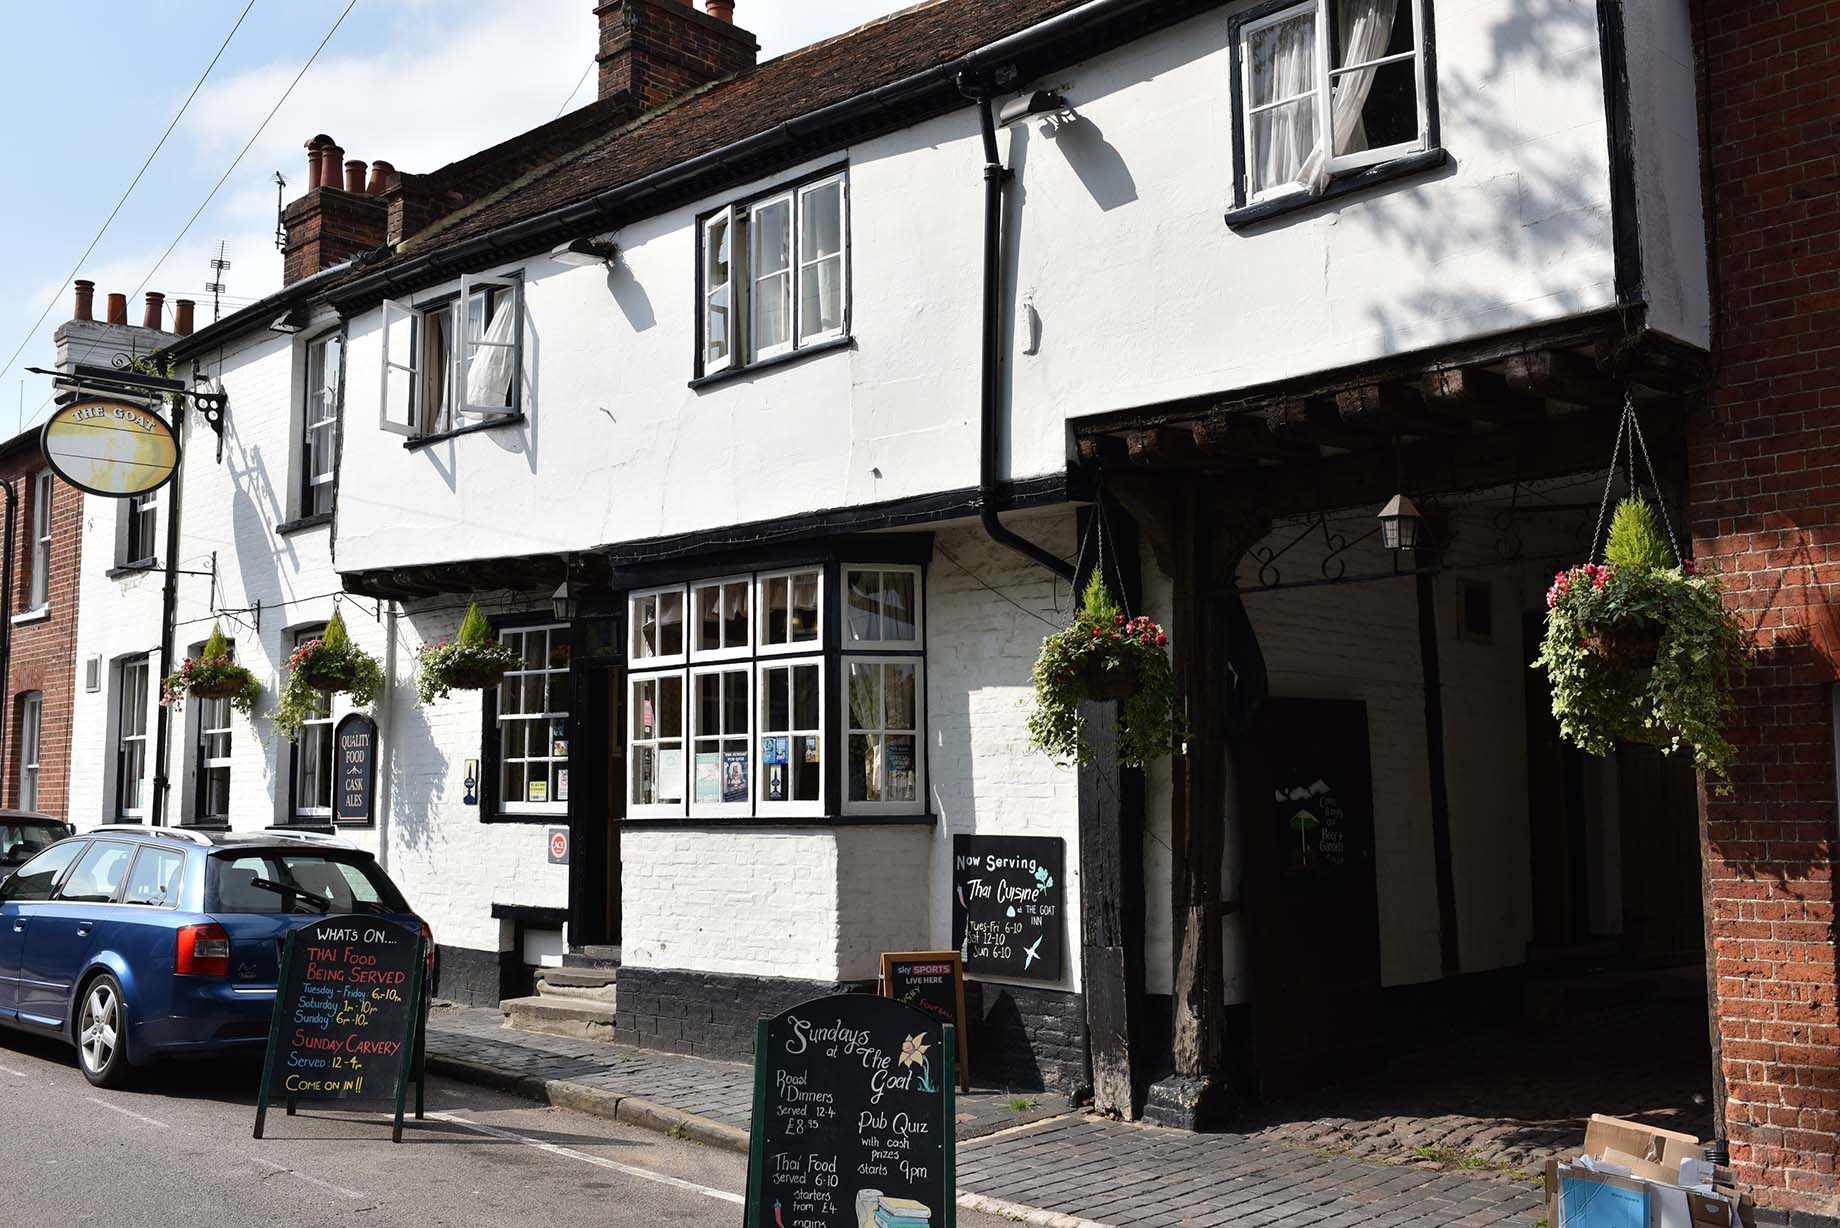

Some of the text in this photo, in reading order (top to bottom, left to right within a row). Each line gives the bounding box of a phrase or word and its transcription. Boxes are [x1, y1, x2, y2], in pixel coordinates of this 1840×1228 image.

[72, 407, 156, 431] THE GOAT
[341, 734, 369, 750] QUALITY
[345, 750, 365, 763] FOOD
[345, 778, 363, 791] CASK
[345, 794, 362, 807] ALES
[957, 855, 1036, 874] Now Serving
[967, 879, 1039, 903] Thai Cuisine
[1026, 905, 1037, 915] THE
[1040, 905, 1055, 916] GOAT
[1005, 922, 1022, 934] 6-10
[1031, 917, 1042, 926] INN
[968, 931, 1005, 945] Sat 12-10
[307, 947, 337, 960] THAI
[973, 946, 1011, 959] Sun 6-10
[307, 962, 405, 984] BEING SERVED
[897, 964, 951, 975] sky SPORTS
[923, 976, 943, 984] HERE
[303, 982, 334, 999] Tuesday
[291, 1028, 400, 1056] SUNDAY CARVERY
[785, 1015, 870, 1054] Sundays
[826, 1047, 838, 1058] at
[856, 1047, 892, 1069] The
[285, 1074, 321, 1091] COME
[324, 1081, 340, 1091] ON
[776, 1069, 808, 1098] Roast
[870, 1069, 913, 1104] Goat
[787, 1085, 834, 1104] Dinners
[858, 1111, 929, 1138] Pub Quiz
[861, 1138, 910, 1149] with cash
[774, 1152, 837, 1173] Thai Food
[871, 1150, 900, 1162] prizes
[857, 1160, 928, 1185] starts 9pm
[793, 1189, 831, 1201] starters
[793, 1202, 838, 1215] from £4
